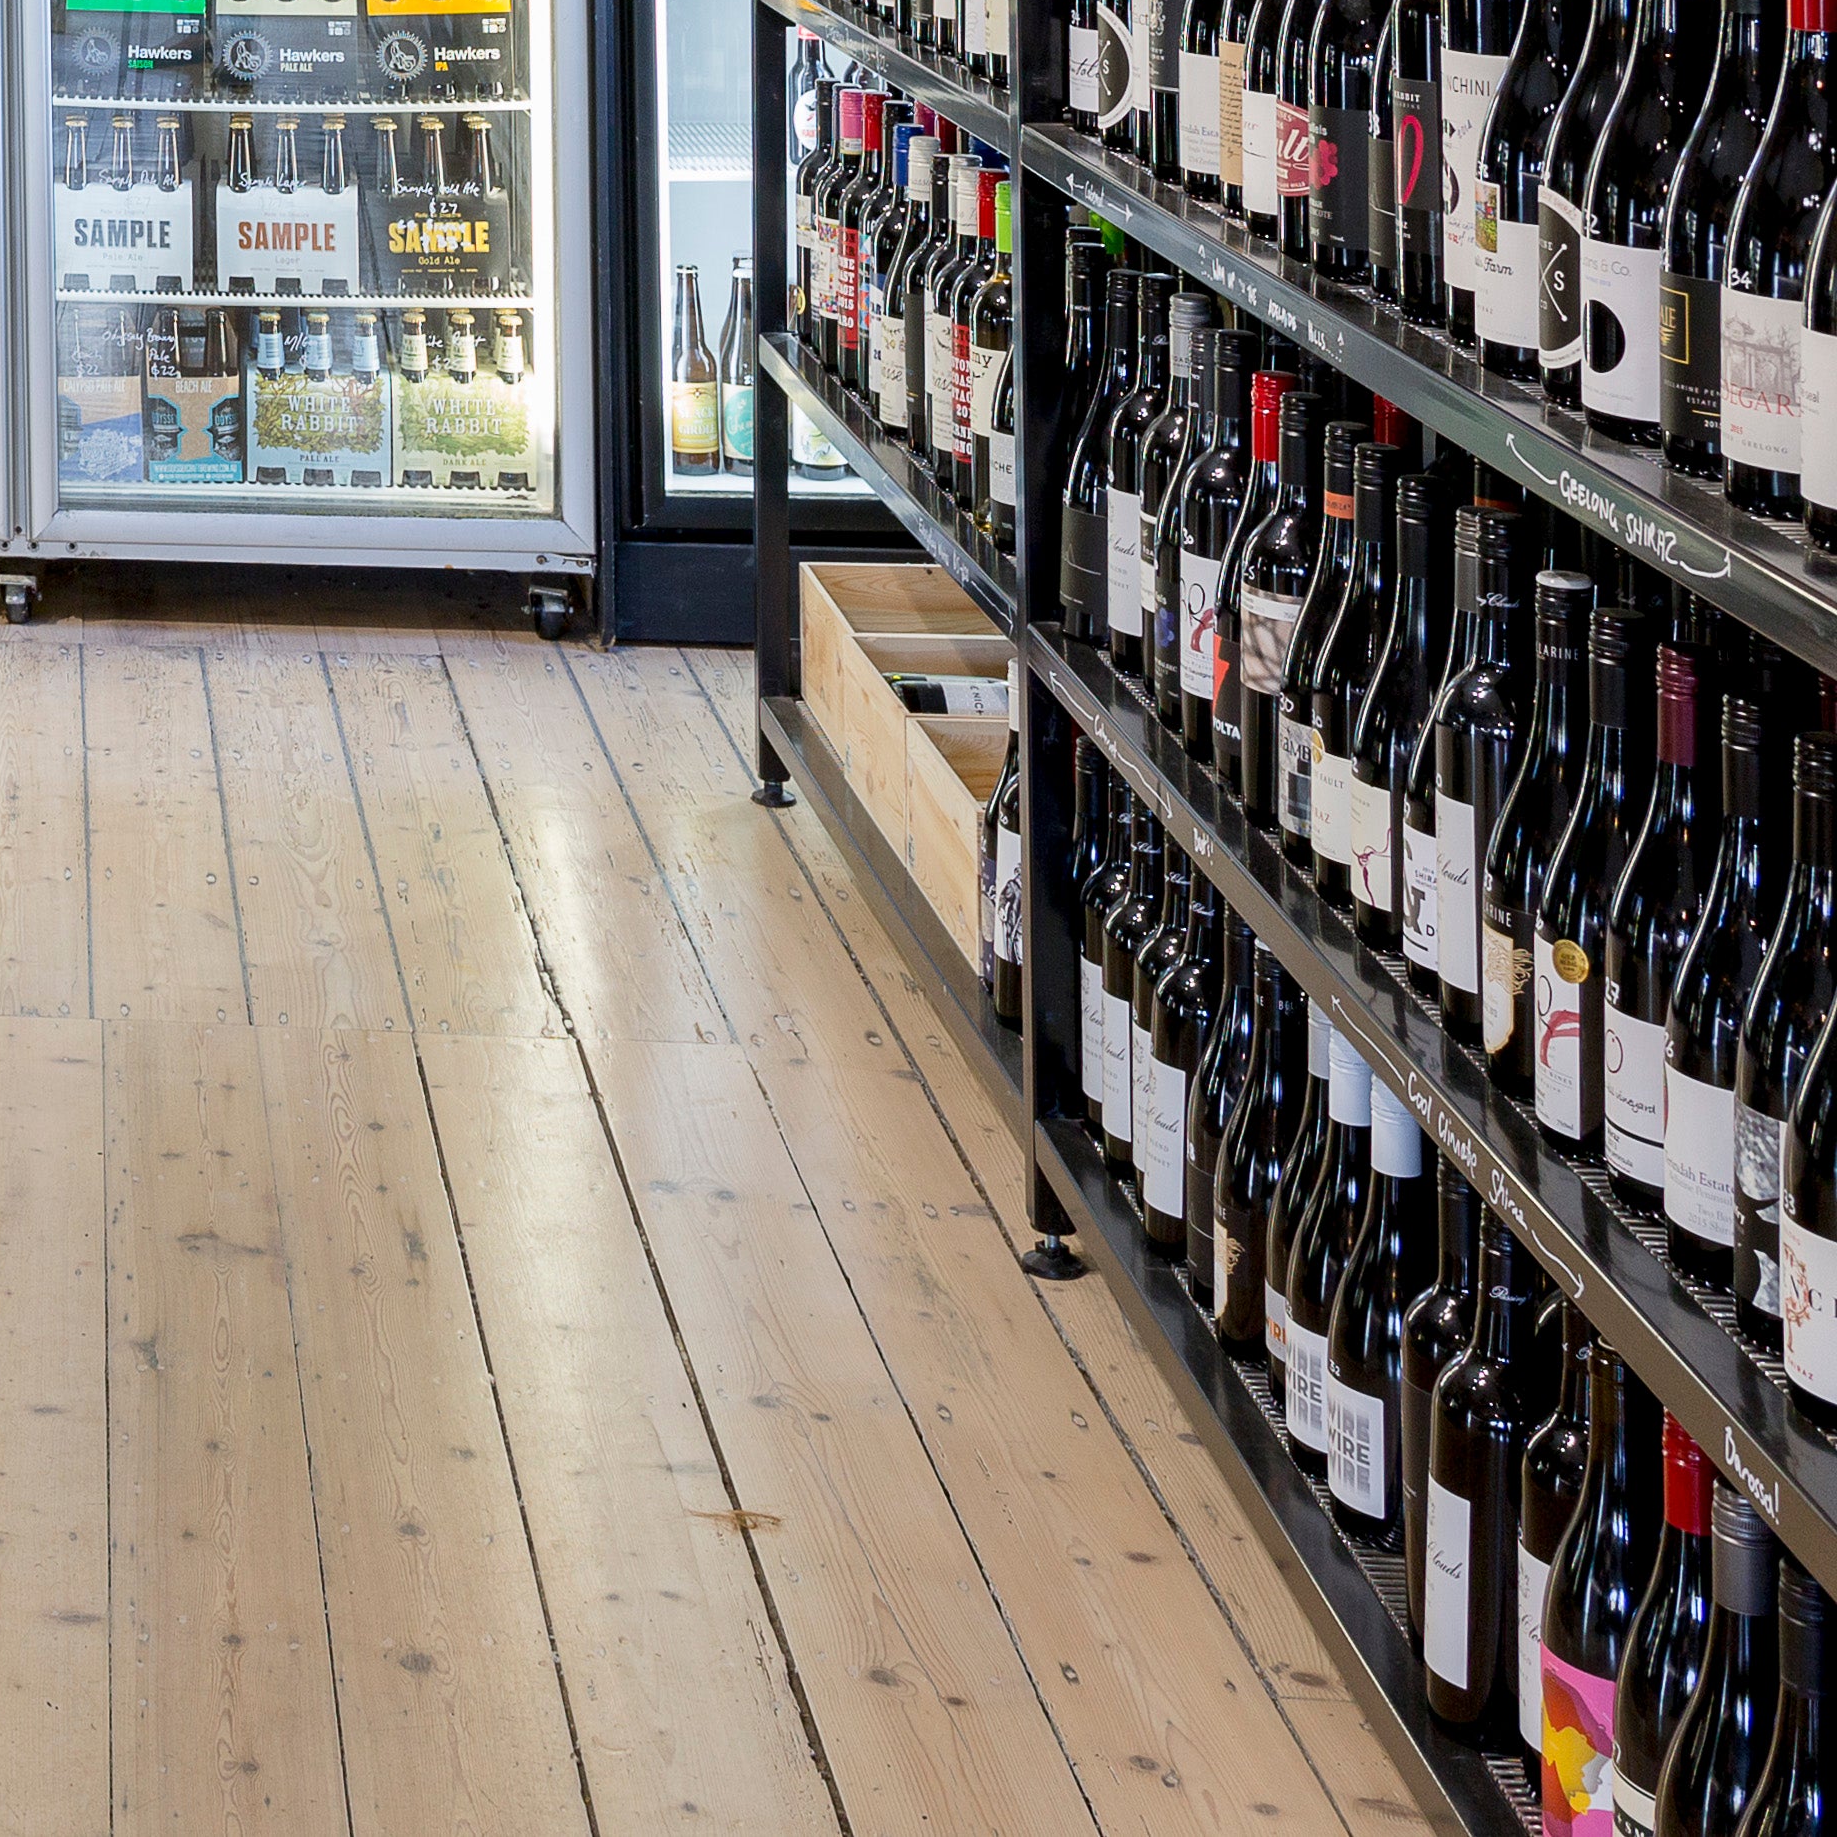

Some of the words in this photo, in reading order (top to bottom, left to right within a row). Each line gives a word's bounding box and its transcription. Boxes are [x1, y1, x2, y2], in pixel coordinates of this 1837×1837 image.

[128, 45, 193, 61] Hawkers
[280, 48, 345, 63] Hawkers
[434, 46, 501, 62] Hawkers
[280, 63, 297, 72] PALE
[298, 63, 313, 72] ALE
[74, 218, 171, 248] SAMPLE
[238, 221, 336, 251] SAMPLE
[389, 220, 491, 253] SAMPLE
[418, 256, 439, 265] Gold
[443, 256, 460, 265] Ale
[1483, 257, 1514, 277] Farm
[1728, 268, 1752, 289] 34
[288, 395, 351, 413] WHITE
[431, 399, 496, 416] WHITE
[281, 414, 359, 432] RABBIT
[425, 417, 502, 435] RABBIT
[1741, 437, 1788, 455] GEELONG
[1559, 469, 1618, 533] GEELONG
[1625, 512, 1679, 566] SHIRAZ
[1408, 1070, 1433, 1124] Cool
[1437, 1111, 1478, 1179] Climate
[1489, 1169, 1527, 1232] Shiraz
[1724, 1424, 1781, 1525] Barossa!
